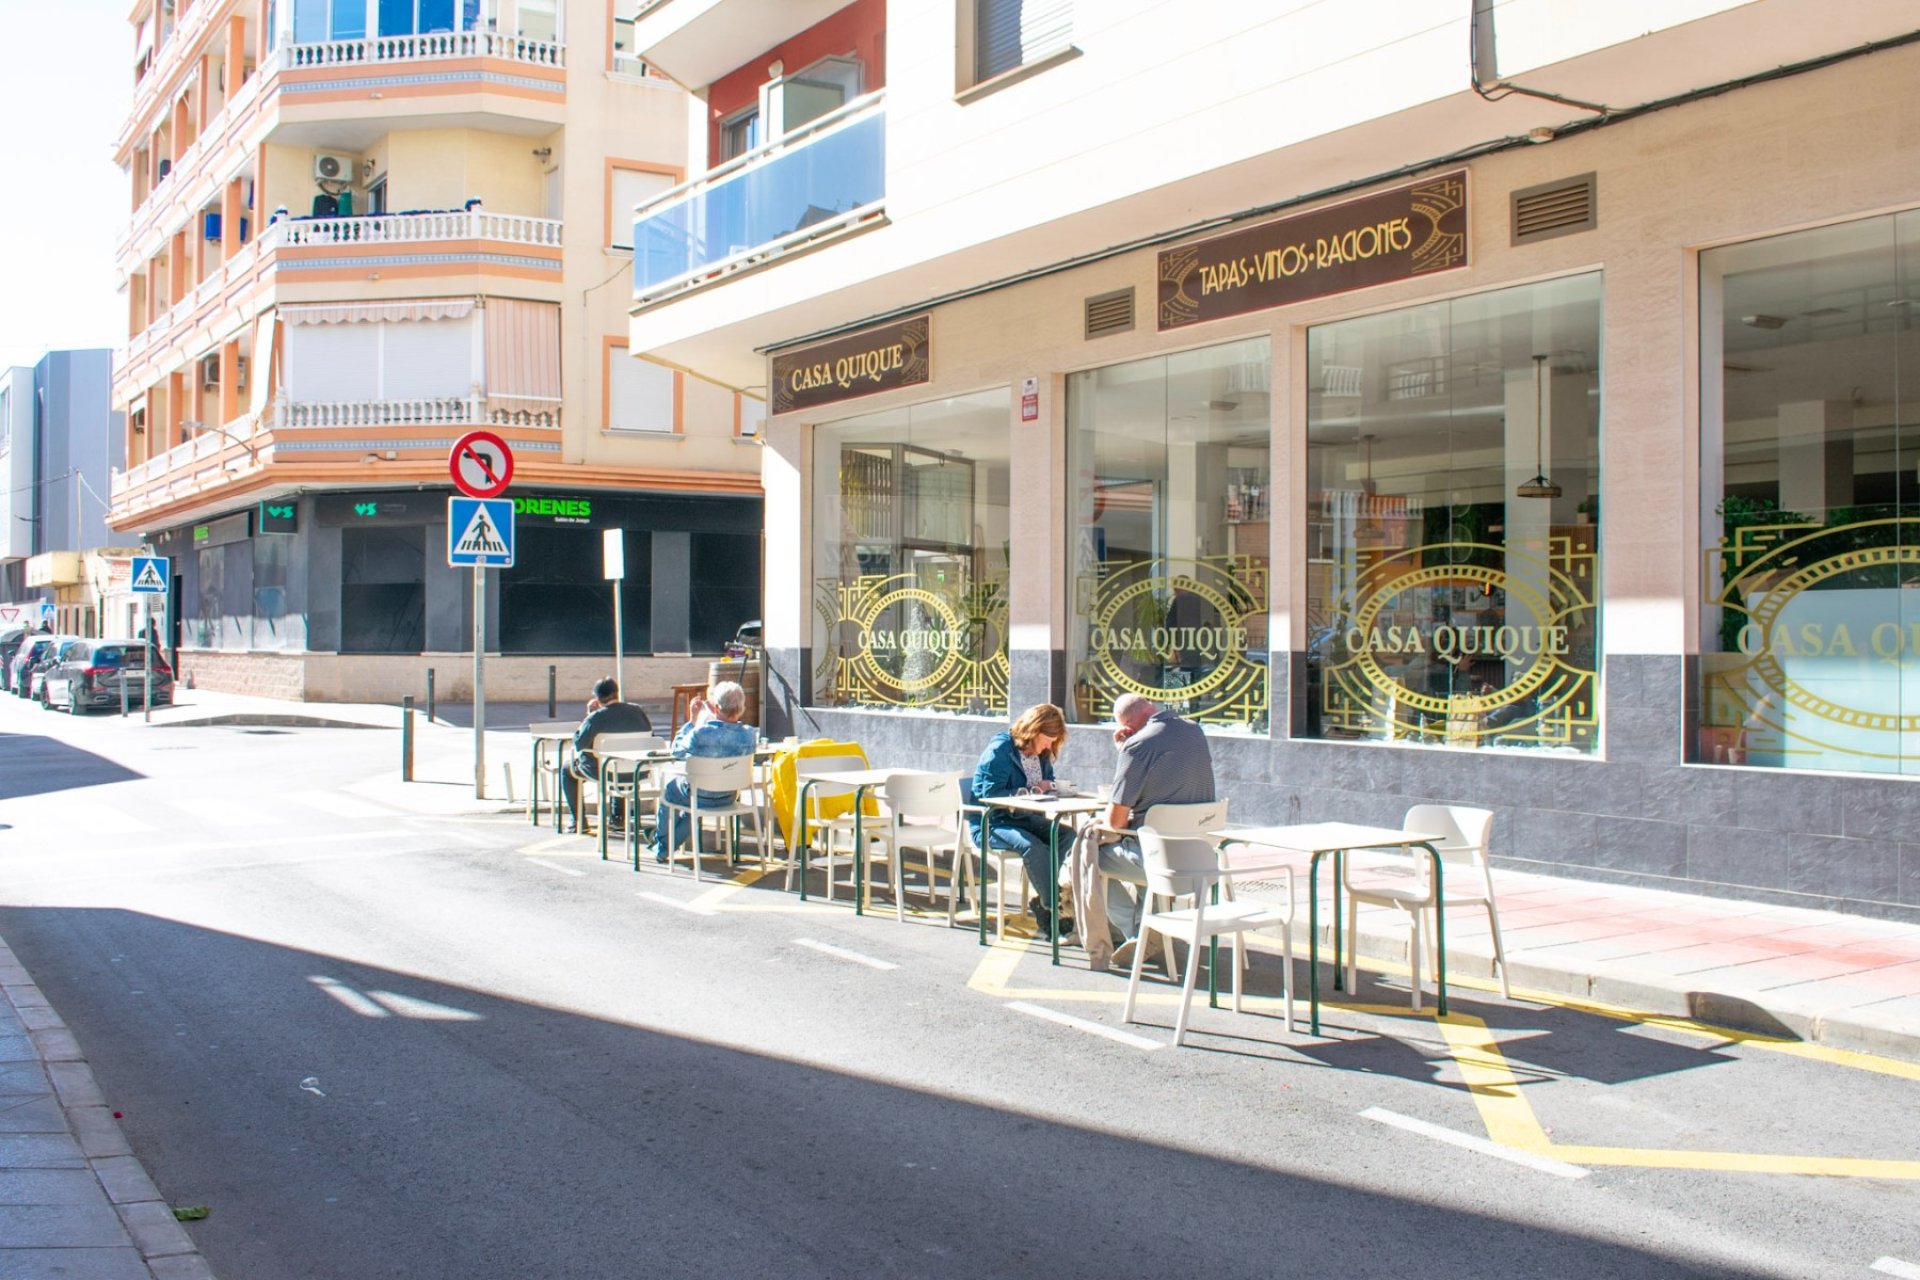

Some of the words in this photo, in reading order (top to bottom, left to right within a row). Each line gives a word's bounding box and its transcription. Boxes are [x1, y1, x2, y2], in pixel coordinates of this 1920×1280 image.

[791, 362, 833, 391] CASA
[836, 344, 903, 388] QUIQUE
[858, 630, 897, 651] CASA
[900, 629, 965, 657] QUIQUE
[1090, 627, 1148, 651] CASA
[1152, 627, 1248, 660] QUIQUE
[1345, 626, 1426, 654] CASA
[1433, 625, 1570, 665] QUIQUE
[1737, 623, 1857, 657] CASA
[1871, 622, 1920, 670] Q
